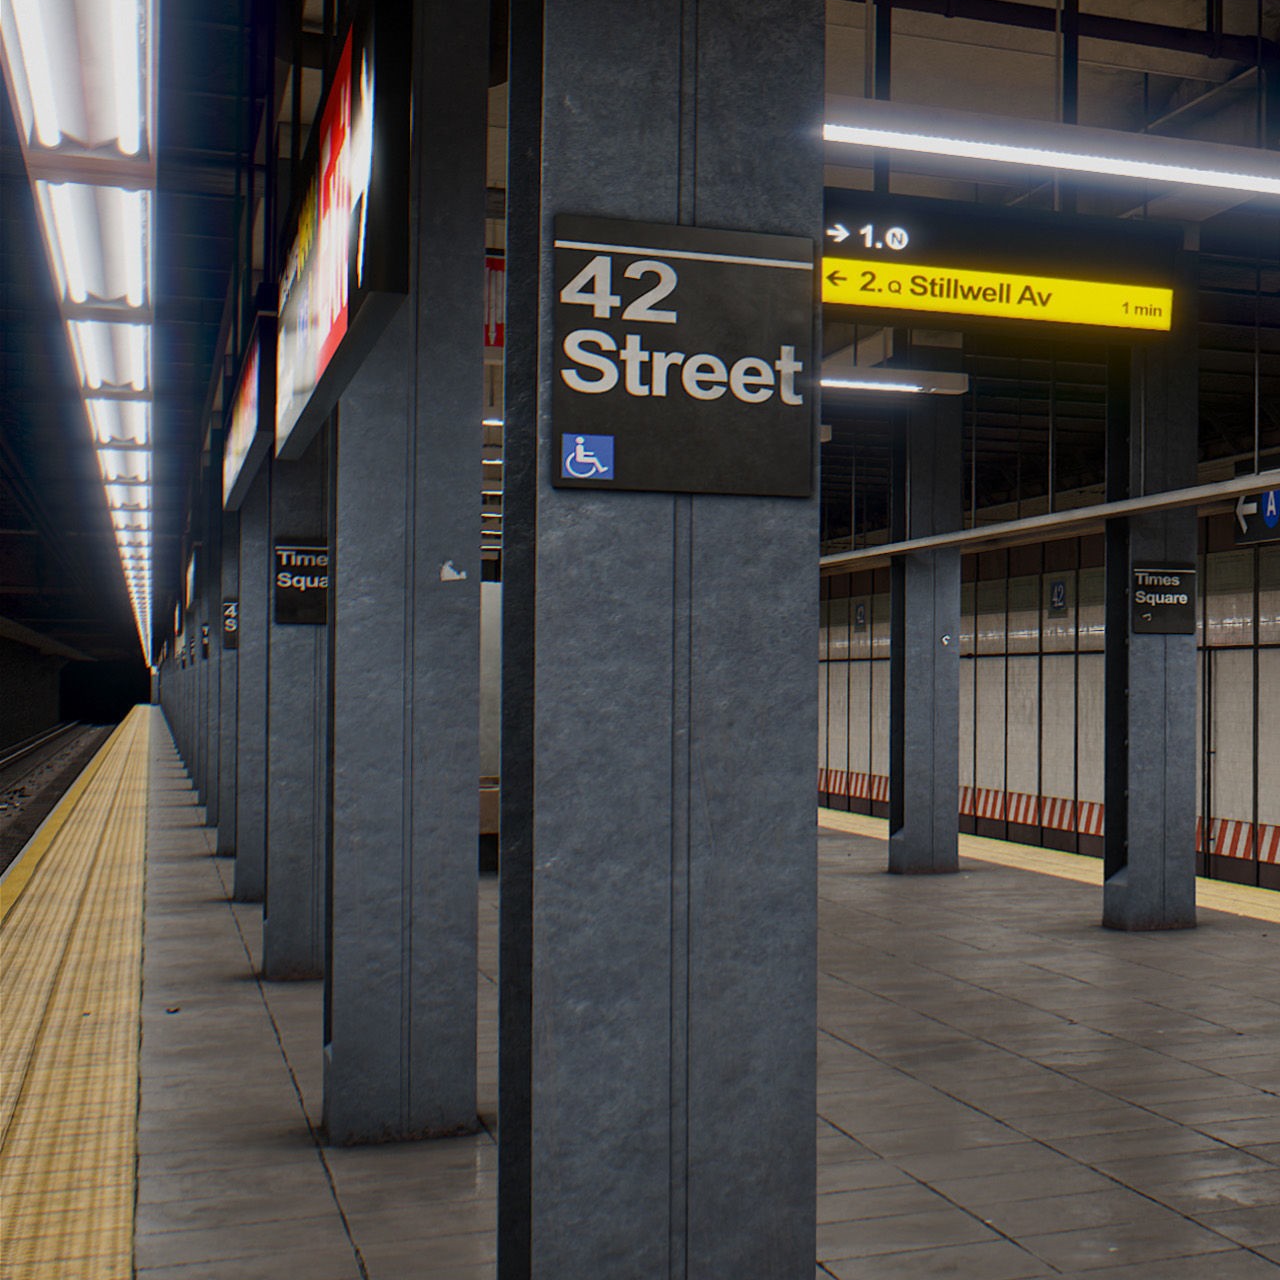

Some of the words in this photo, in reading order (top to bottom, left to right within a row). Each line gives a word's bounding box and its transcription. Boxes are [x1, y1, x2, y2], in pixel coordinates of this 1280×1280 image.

[560, 255, 678, 324] 42
[860, 270, 883, 293] 2.
[887, 280, 902, 296] Q
[909, 274, 1012, 304] Stillwell
[1016, 284, 1053, 307] Av
[1121, 301, 1130, 315] 1
[1134, 303, 1163, 318] min
[560, 328, 804, 406] Street
[1266, 490, 1277, 517] A
[1134, 572, 1181, 587] Times
[1135, 590, 1188, 607] Square
